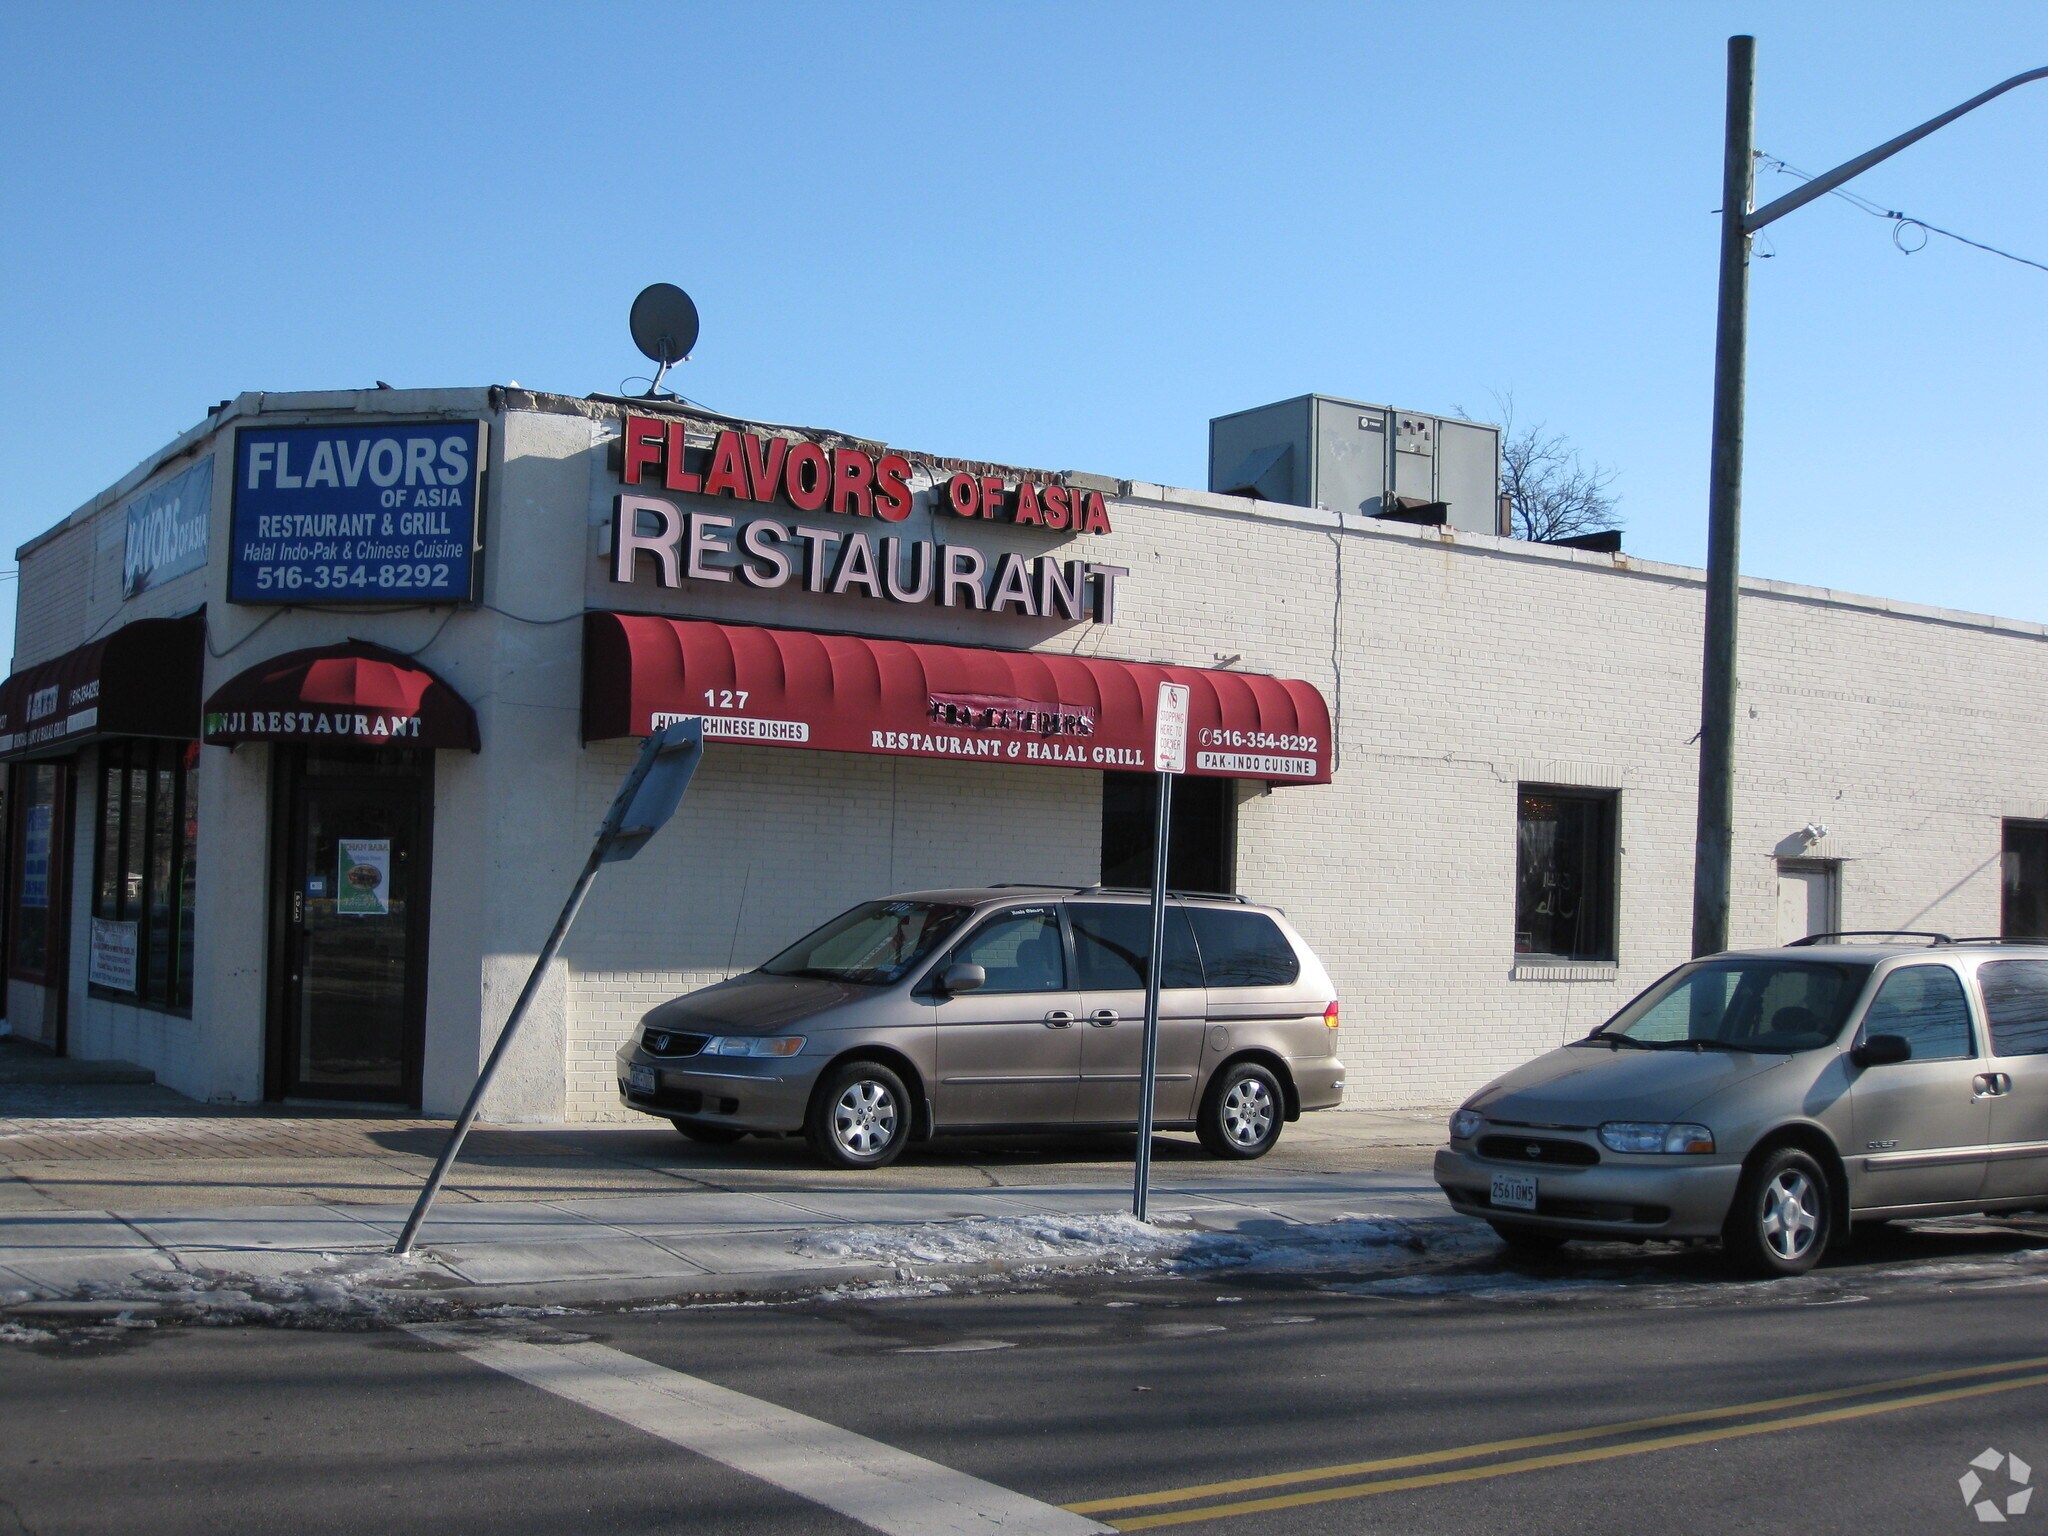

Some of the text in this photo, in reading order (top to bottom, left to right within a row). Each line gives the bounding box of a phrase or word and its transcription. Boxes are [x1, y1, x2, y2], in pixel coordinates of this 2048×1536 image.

[248, 437, 469, 489] FLAVORS
[622, 415, 1112, 535] FLAVORS OF ASIA
[381, 488, 462, 508] OF ASIA
[258, 512, 451, 538] RESTAURANT & GRILL
[243, 540, 463, 561] Halal Indo-Pak & Chinese Cuisine
[611, 494, 1129, 624] RESTAURANT
[257, 564, 449, 589] 516-354-8292
[704, 688, 749, 709] 127
[252, 712, 422, 737] RESTAURANT
[702, 717, 755, 736] CHINESE
[759, 722, 803, 740] DISHES
[1160, 710, 1184, 724] STOPPING
[872, 730, 1145, 766] RESTAURANT & HALAL GRILL
[1212, 730, 1318, 753] 516-354-8292
[1264, 757, 1310, 774] CUISINE
